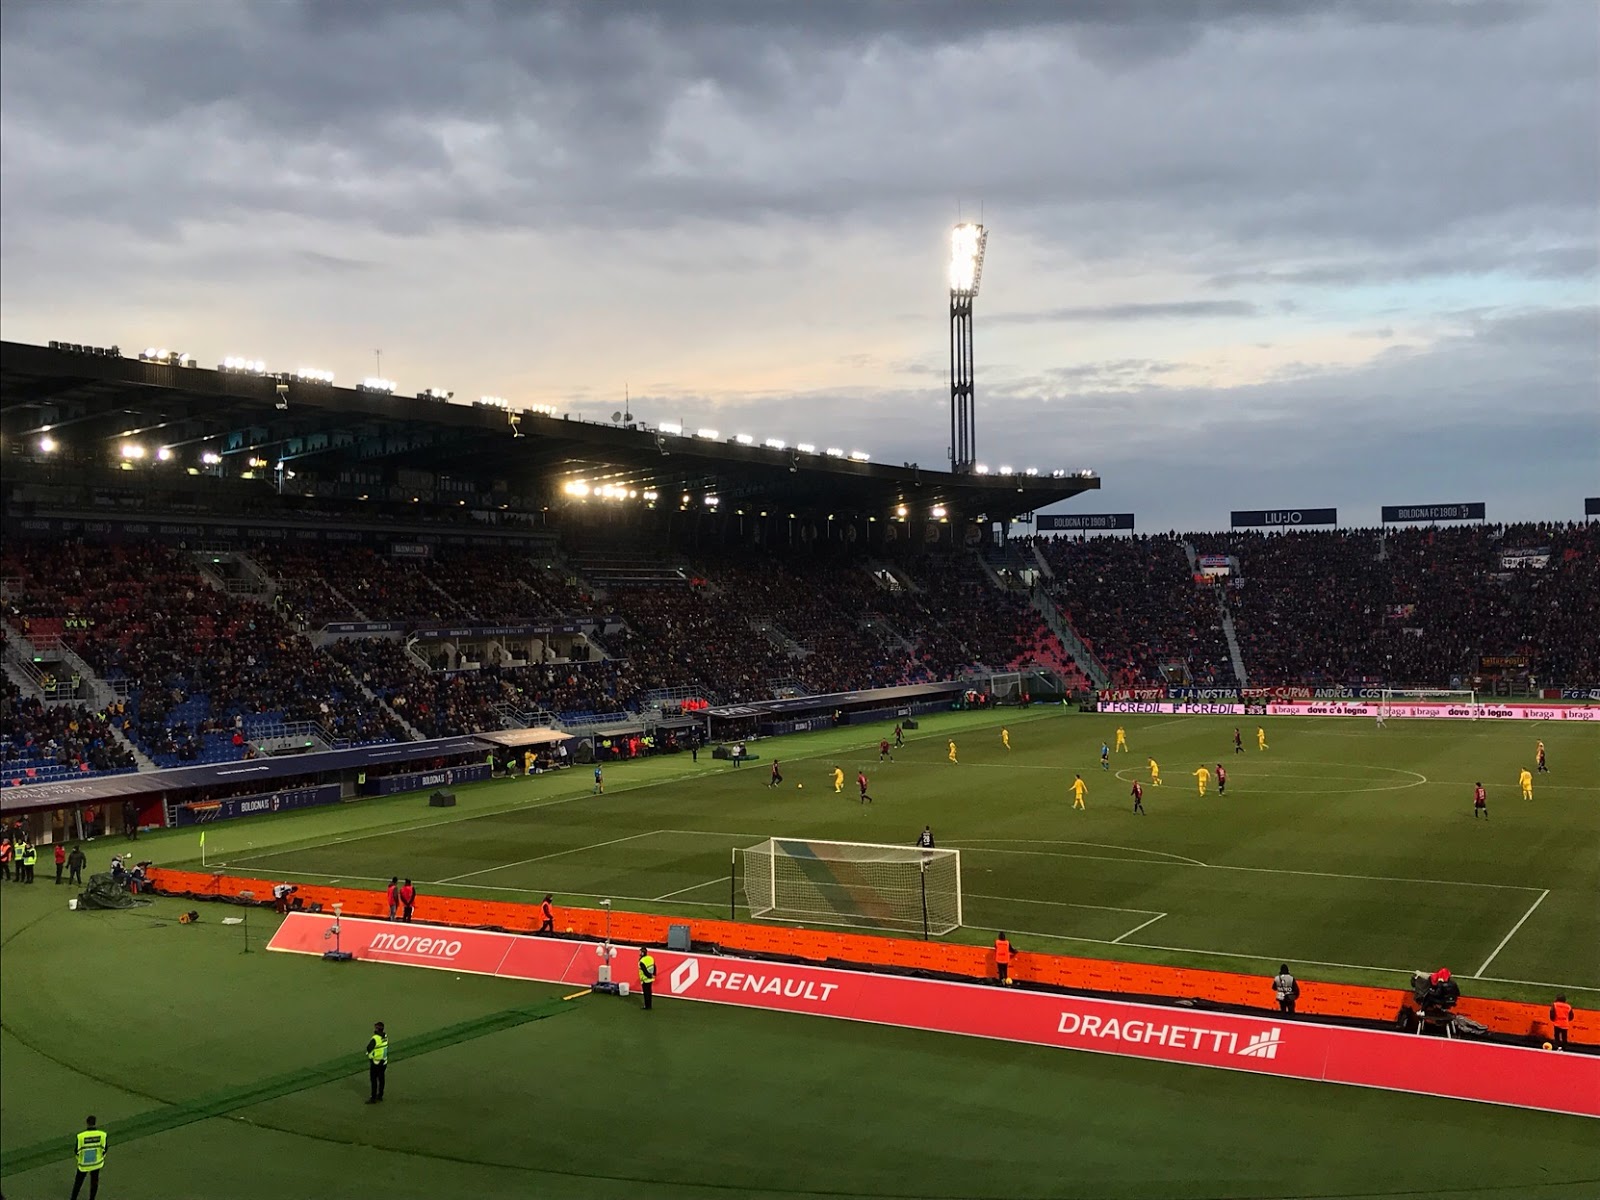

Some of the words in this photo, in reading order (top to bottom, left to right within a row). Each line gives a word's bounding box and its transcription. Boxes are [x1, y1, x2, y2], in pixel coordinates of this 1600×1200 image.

[1398, 509, 1429, 520] BOLOGNA
[1430, 508, 1439, 518] FC
[1440, 507, 1457, 517] 1909
[1053, 517, 1081, 528] BOLOGNA
[1081, 517, 1090, 527] FC
[1090, 517, 1106, 527] 1909
[1196, 688, 1238, 699] NOSTRA
[1241, 687, 1270, 698] FEDE
[1275, 687, 1310, 698] CURVA
[1314, 687, 1354, 699] ANDREA
[1359, 688, 1393, 699] COSTA
[1113, 703, 1163, 713] FCREDIL
[1185, 704, 1238, 714] FCREDIL
[1278, 706, 1300, 716] braga
[1307, 706, 1327, 714] dove
[1329, 705, 1342, 714] c'è
[1344, 706, 1368, 716] legno
[1416, 707, 1440, 717] braga
[1448, 709, 1470, 717] dove
[1488, 709, 1513, 719] legno
[1529, 709, 1554, 720] braga
[1568, 710, 1594, 721] braga
[422, 775, 440, 787] BOLOGNA
[241, 799, 264, 812] BOLOGNA
[371, 931, 462, 959] moreno
[705, 969, 838, 1004] RENAULT
[1058, 1011, 1238, 1055] DRAGHETTI
